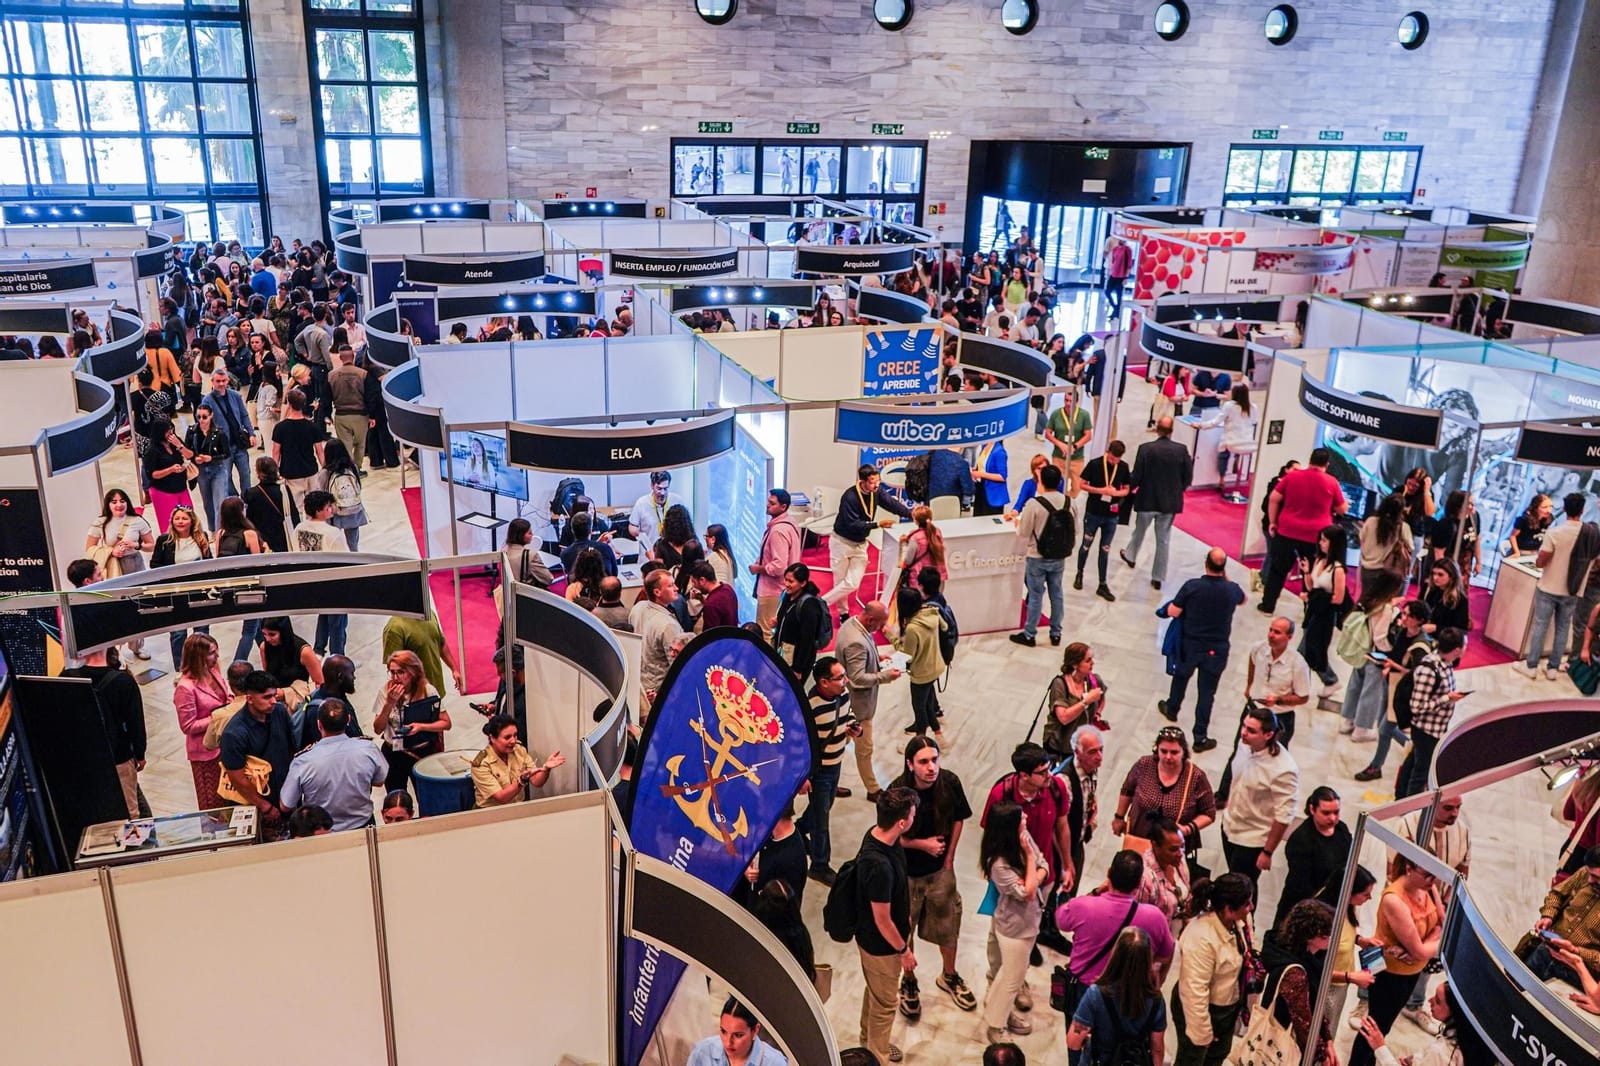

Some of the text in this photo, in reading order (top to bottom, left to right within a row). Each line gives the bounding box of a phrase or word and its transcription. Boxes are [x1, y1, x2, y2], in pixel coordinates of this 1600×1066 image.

[615, 261, 645, 271] INSERTA
[645, 263, 676, 272] EMPLEO
[677, 262, 682, 272] /
[683, 260, 721, 271] FUNDACIÓN
[843, 260, 880, 269] Arquisocial
[465, 270, 493, 278] Atende
[16, 283, 29, 291] de
[30, 282, 52, 290] Dios
[878, 360, 921, 377] CRECE
[882, 379, 921, 391] APRENDE
[1329, 404, 1381, 428] SOFTWARE
[881, 420, 945, 441] wiber
[611, 447, 642, 460] ELCA
[4, 557, 44, 566] to drive
[1511, 1014, 1568, 1066] T-SY
